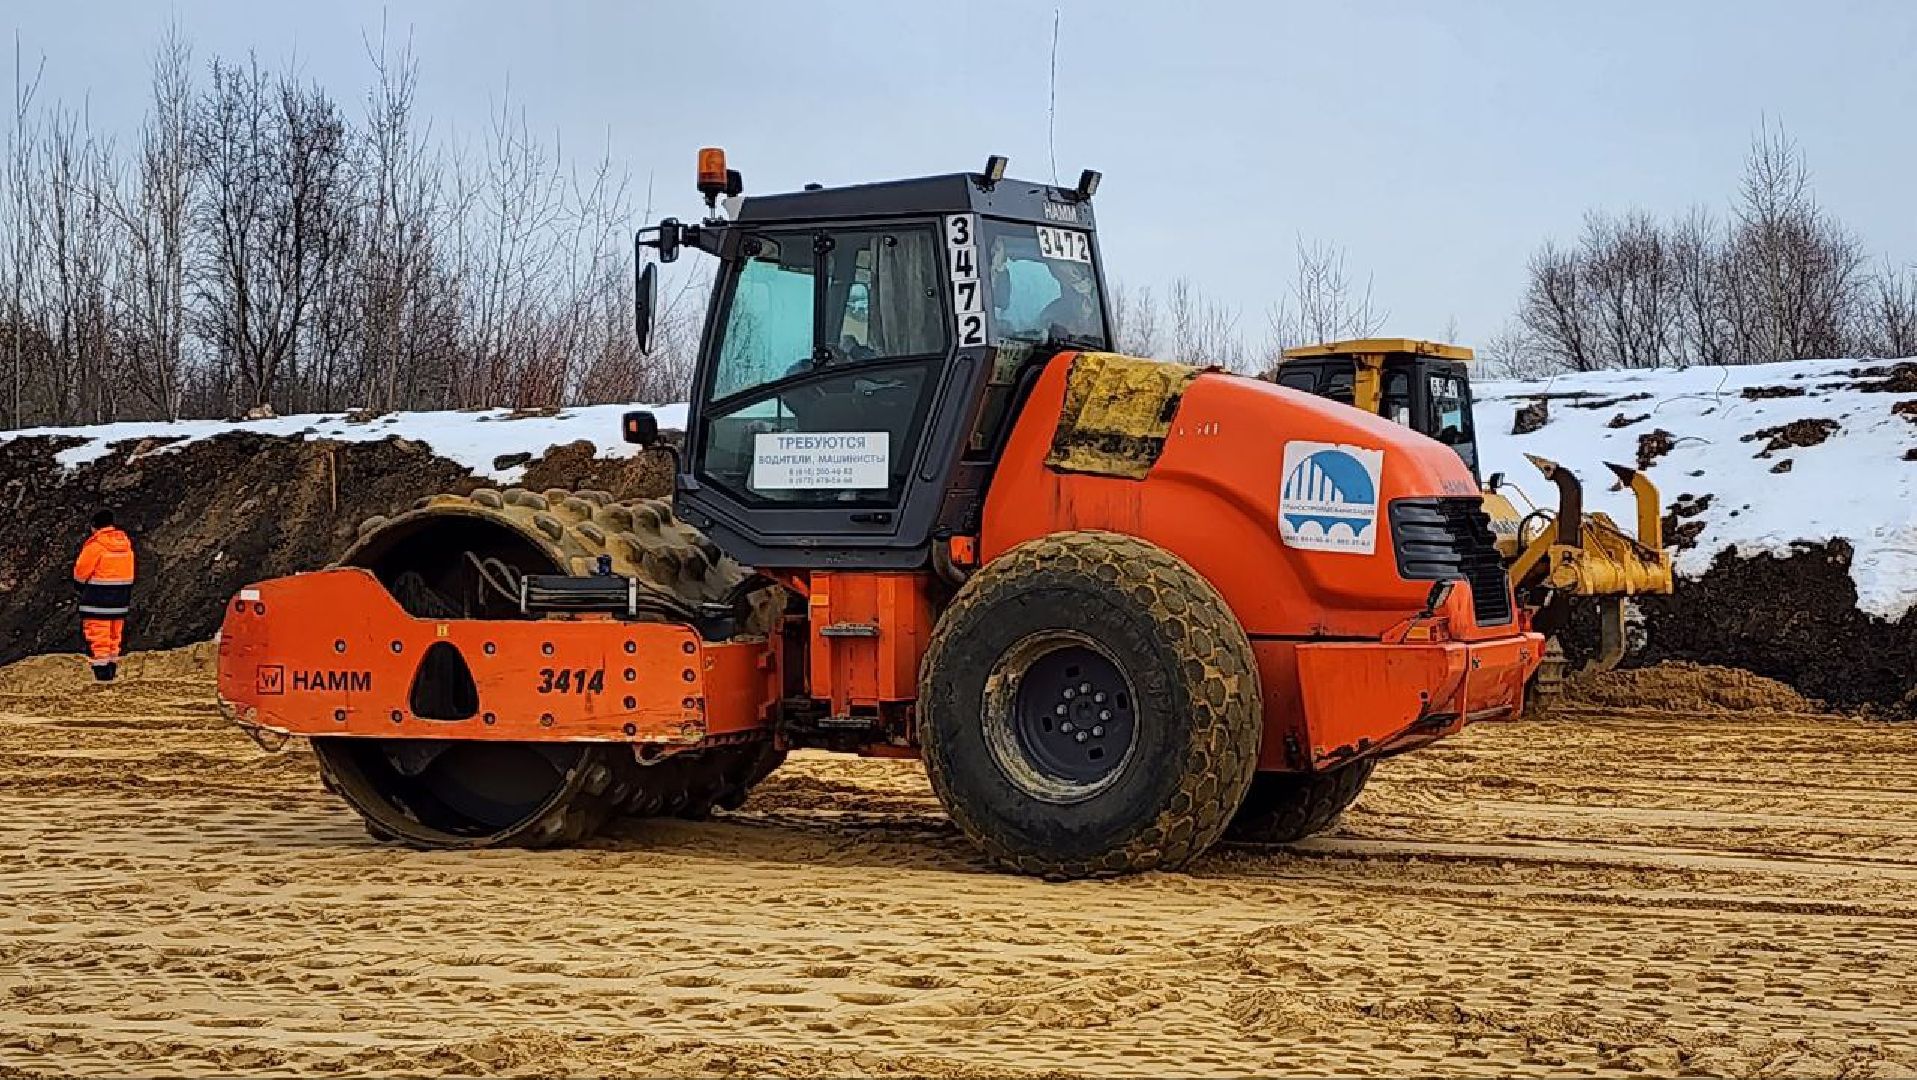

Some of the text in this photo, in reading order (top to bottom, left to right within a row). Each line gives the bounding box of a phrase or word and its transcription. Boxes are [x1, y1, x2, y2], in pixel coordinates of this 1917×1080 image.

[1043, 202, 1077, 221] HAMM
[1040, 229, 1088, 261] 3472
[777, 436, 866, 449] ТРЕБУЮТСЯ
[818, 454, 886, 464] МАШИНИСТЫ
[292, 671, 372, 692] HAMM
[536, 667, 606, 694] 3414
